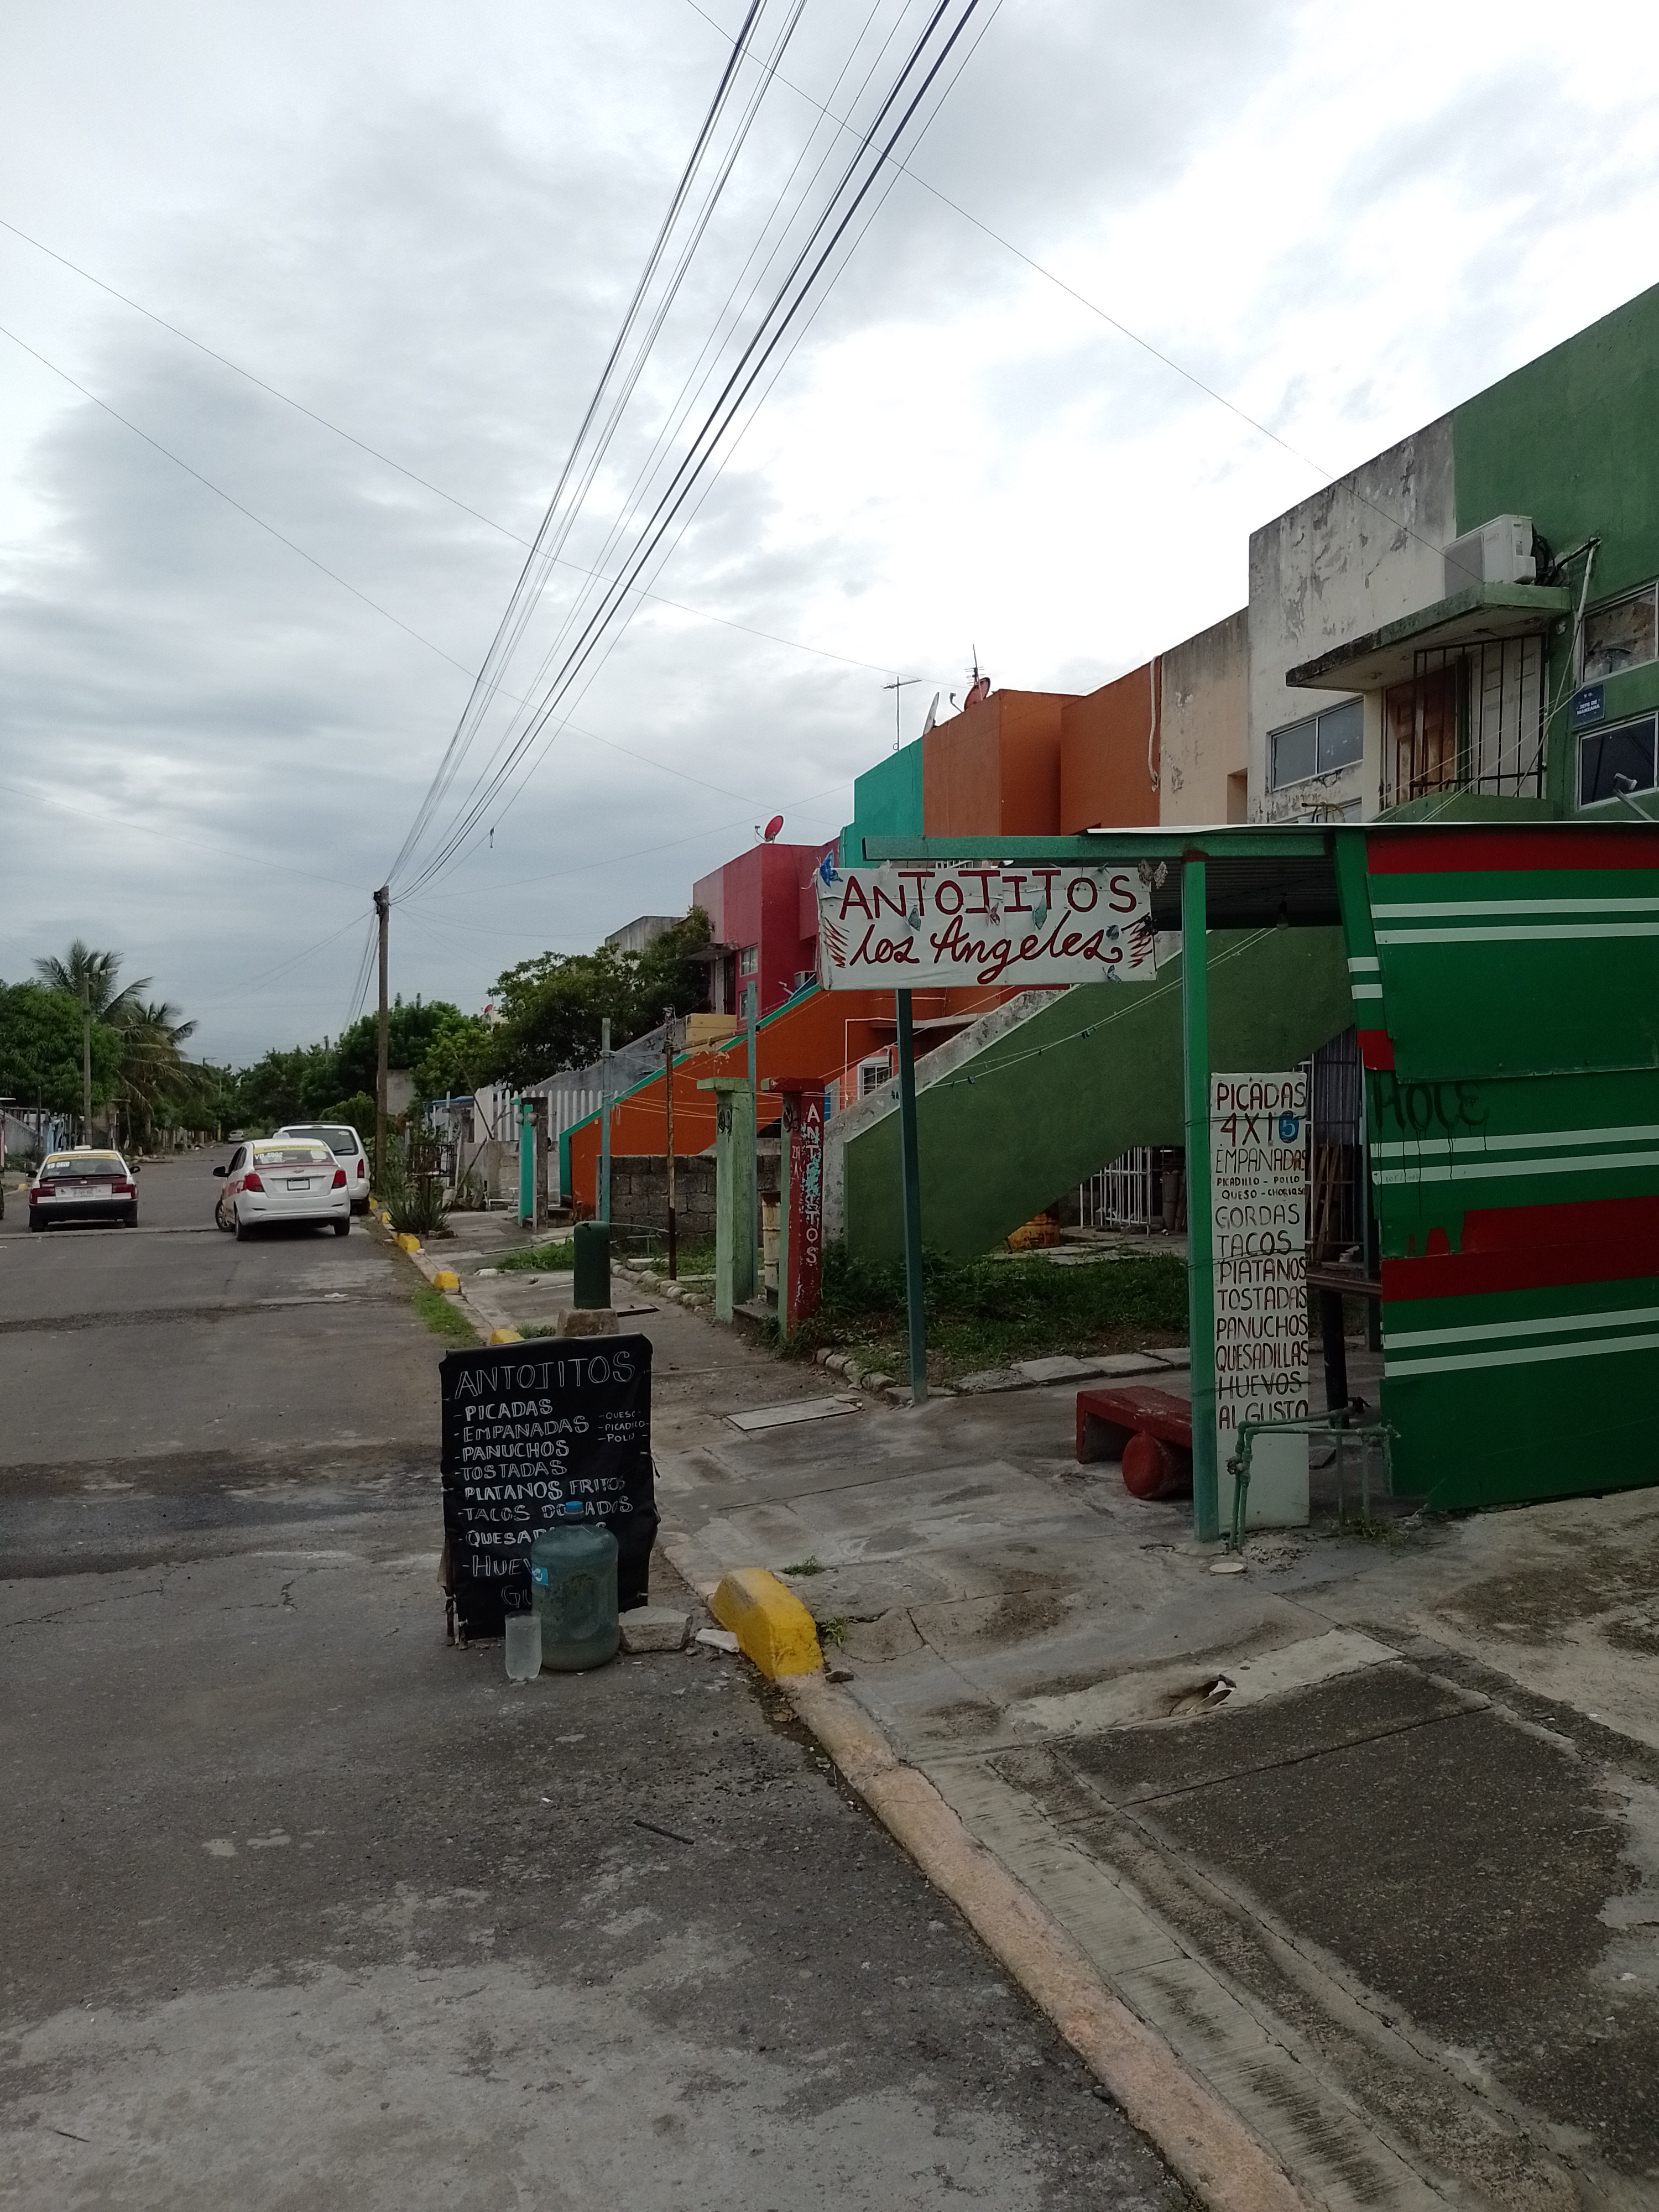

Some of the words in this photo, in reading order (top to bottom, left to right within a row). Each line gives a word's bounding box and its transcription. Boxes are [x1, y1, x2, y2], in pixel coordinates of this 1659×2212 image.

[839, 869, 1137, 920] ANTOJITOS
[849, 924, 920, 966] los
[930, 909, 1123, 985] Angeles
[1217, 1082, 1306, 1111] PICADAS
[1217, 1176, 1260, 1187] PICADILLO
[1222, 1189, 1258, 1201] QUESO
[1215, 1203, 1300, 1229] GORDAS
[1217, 1230, 1292, 1257] TACOS
[1217, 1286, 1307, 1311] TOSTADAS
[1217, 1314, 1308, 1341] PANUCHOS
[1215, 1340, 1308, 1373] QUESADILLAS
[454, 1350, 635, 1400] ANTOJITOS
[1218, 1371, 1302, 1400] HUEVOS
[465, 1399, 554, 1422] PICADAS
[463, 1415, 589, 1443] EMPANADAS
[462, 1439, 570, 1463] PANUCHOS
[460, 1459, 567, 1481] TOSTADAS
[464, 1480, 563, 1501] PLATANOS
[569, 1475, 625, 1495] FRITOS
[463, 1504, 531, 1522] TACOS
[541, 1495, 633, 1519] DOADOS
